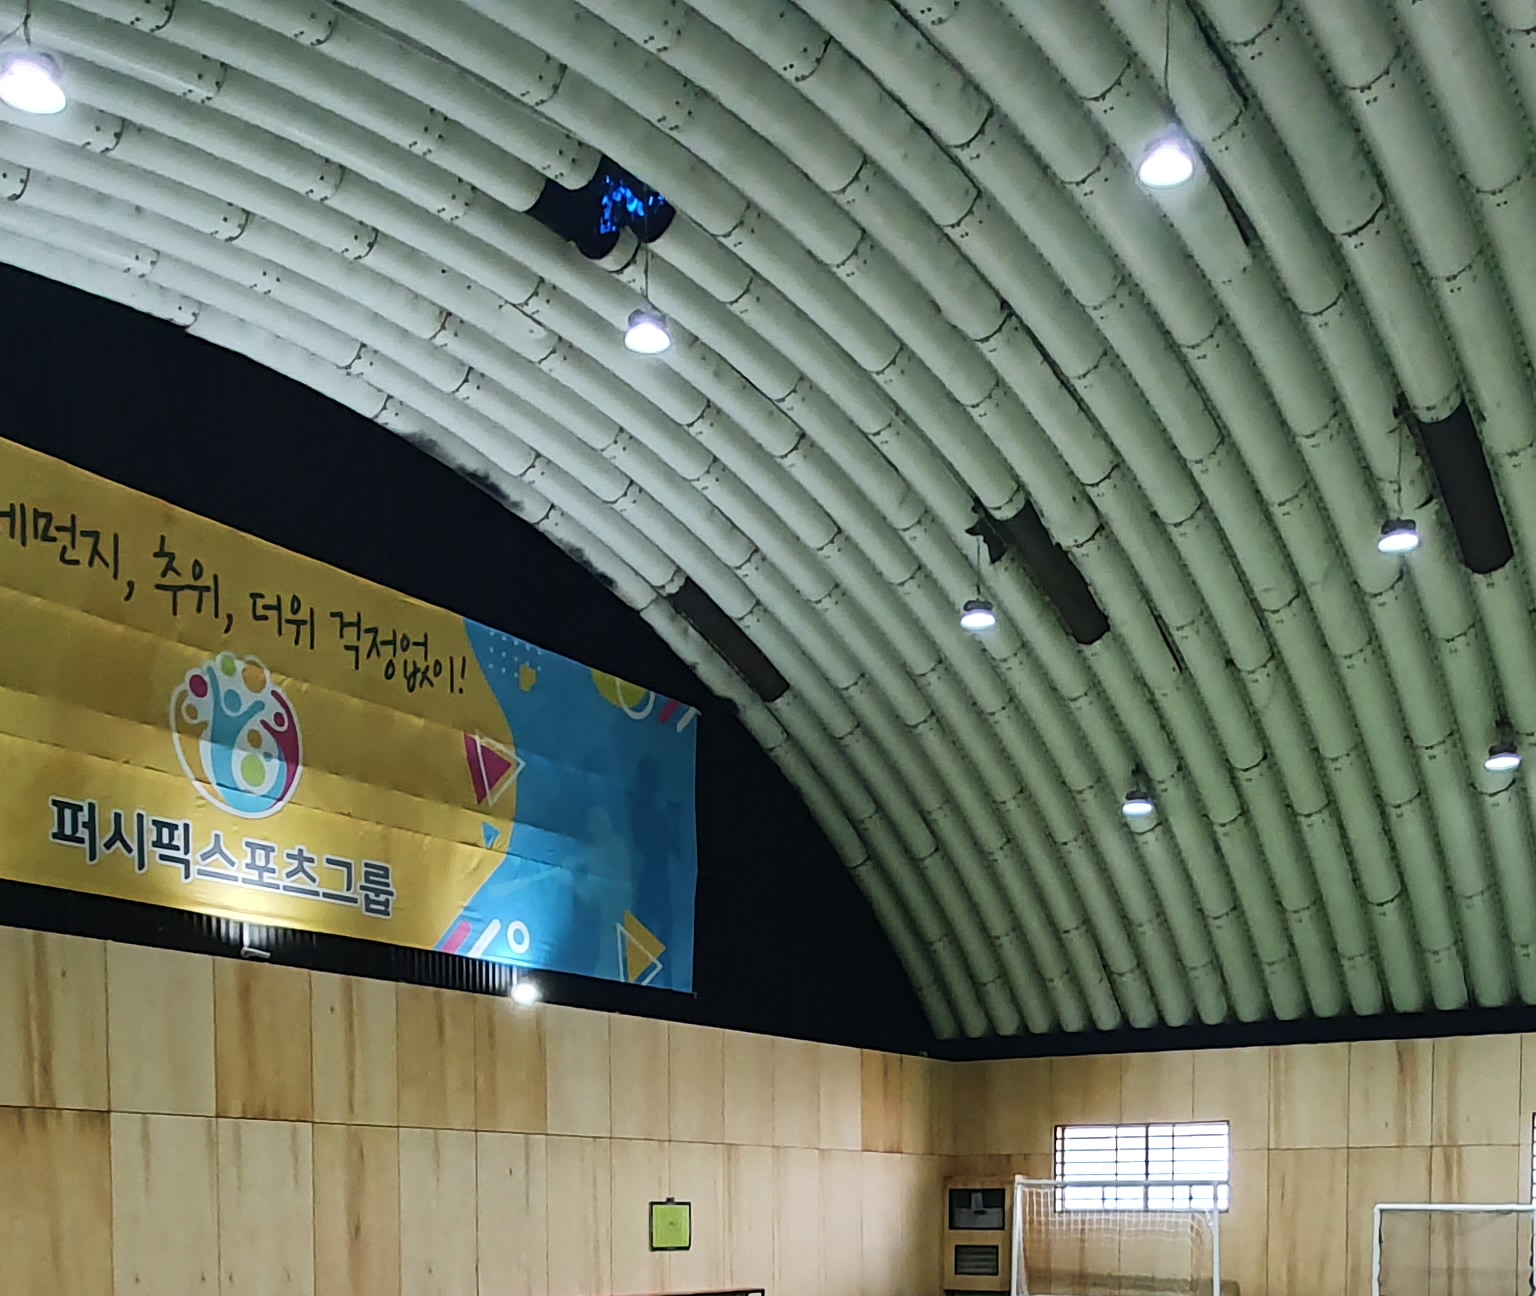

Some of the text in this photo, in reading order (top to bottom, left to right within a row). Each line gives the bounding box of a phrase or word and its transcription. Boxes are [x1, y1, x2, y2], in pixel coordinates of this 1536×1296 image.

[153, 535, 234, 635] 추위,
[250, 592, 315, 650] 더위
[330, 610, 467, 694] 걱정없이!
[49, 796, 396, 918] 퍼시픽스포츠그룹
